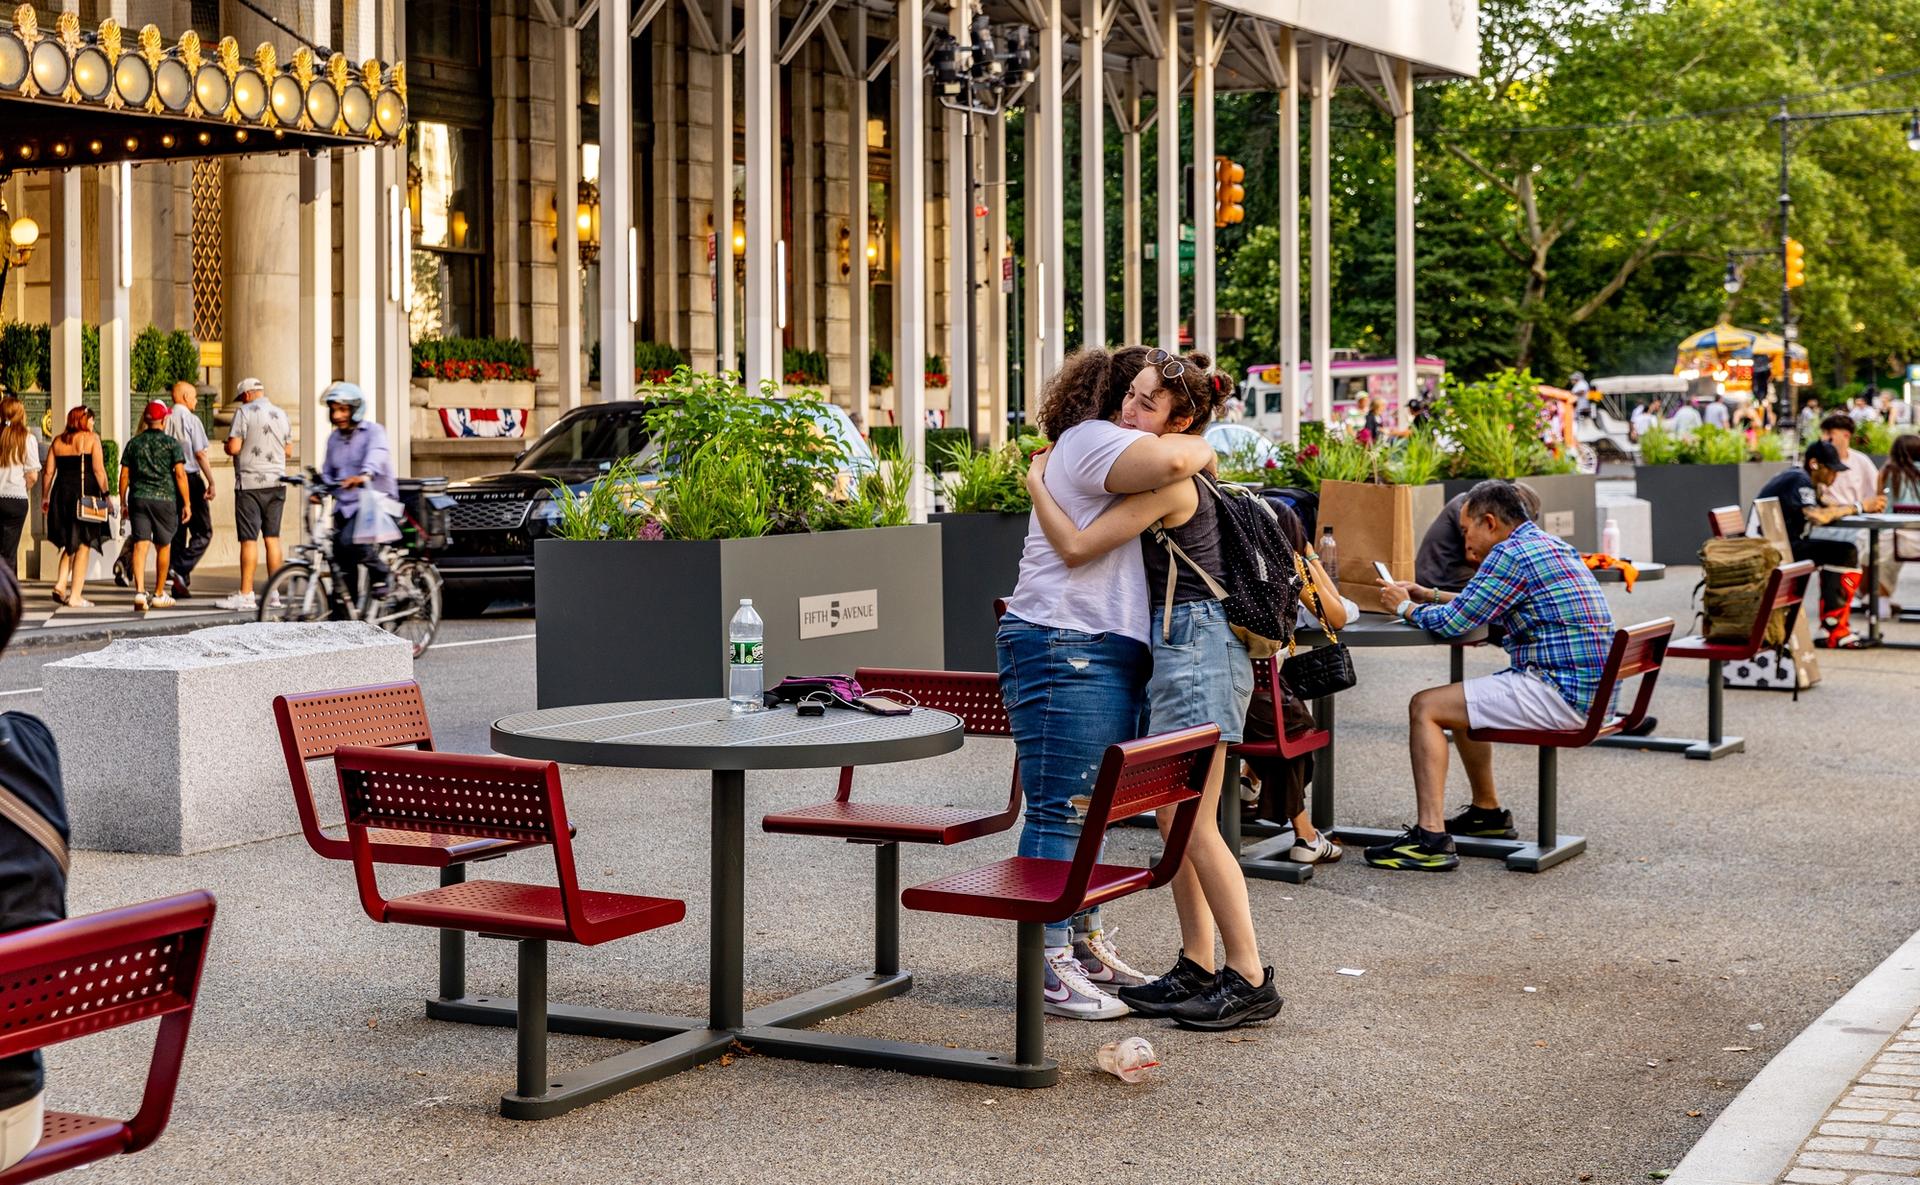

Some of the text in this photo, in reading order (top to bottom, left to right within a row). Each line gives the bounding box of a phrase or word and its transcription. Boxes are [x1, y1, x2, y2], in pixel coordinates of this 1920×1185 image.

[804, 600, 874, 628] FIFTH 5 AVENUE
